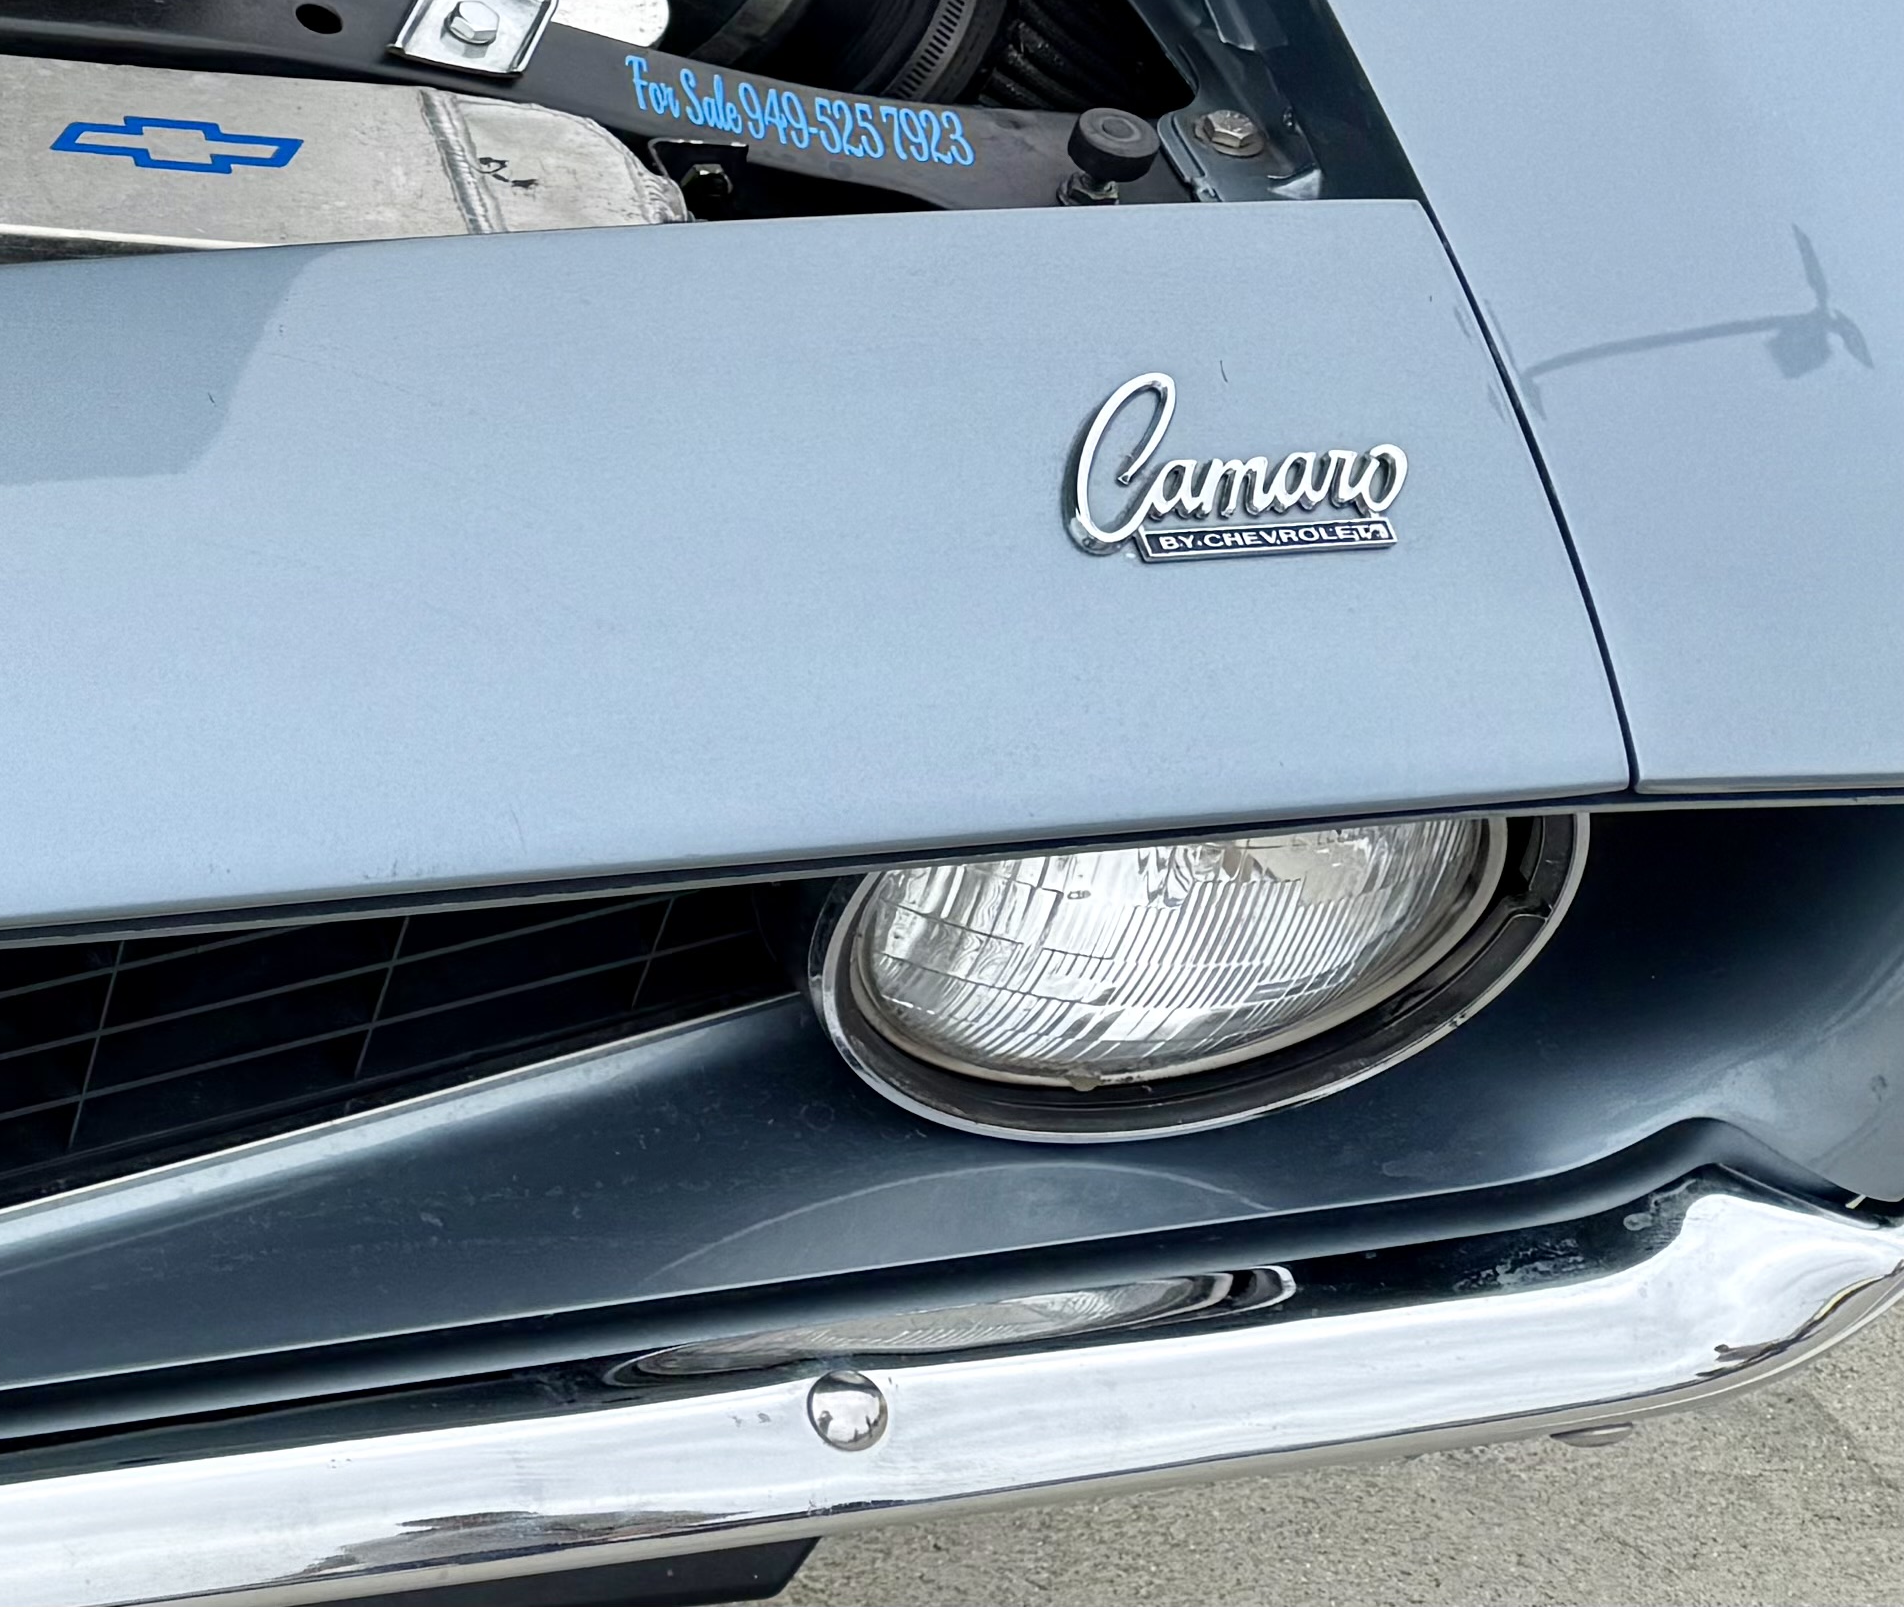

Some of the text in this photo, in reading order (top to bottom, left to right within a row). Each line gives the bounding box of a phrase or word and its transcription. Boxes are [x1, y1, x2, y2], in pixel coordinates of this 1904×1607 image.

[625, 54, 680, 120] For
[679, 68, 743, 135] Sale
[1076, 371, 1409, 543] Camaro
[1202, 524, 1374, 547] CHEVROLET
